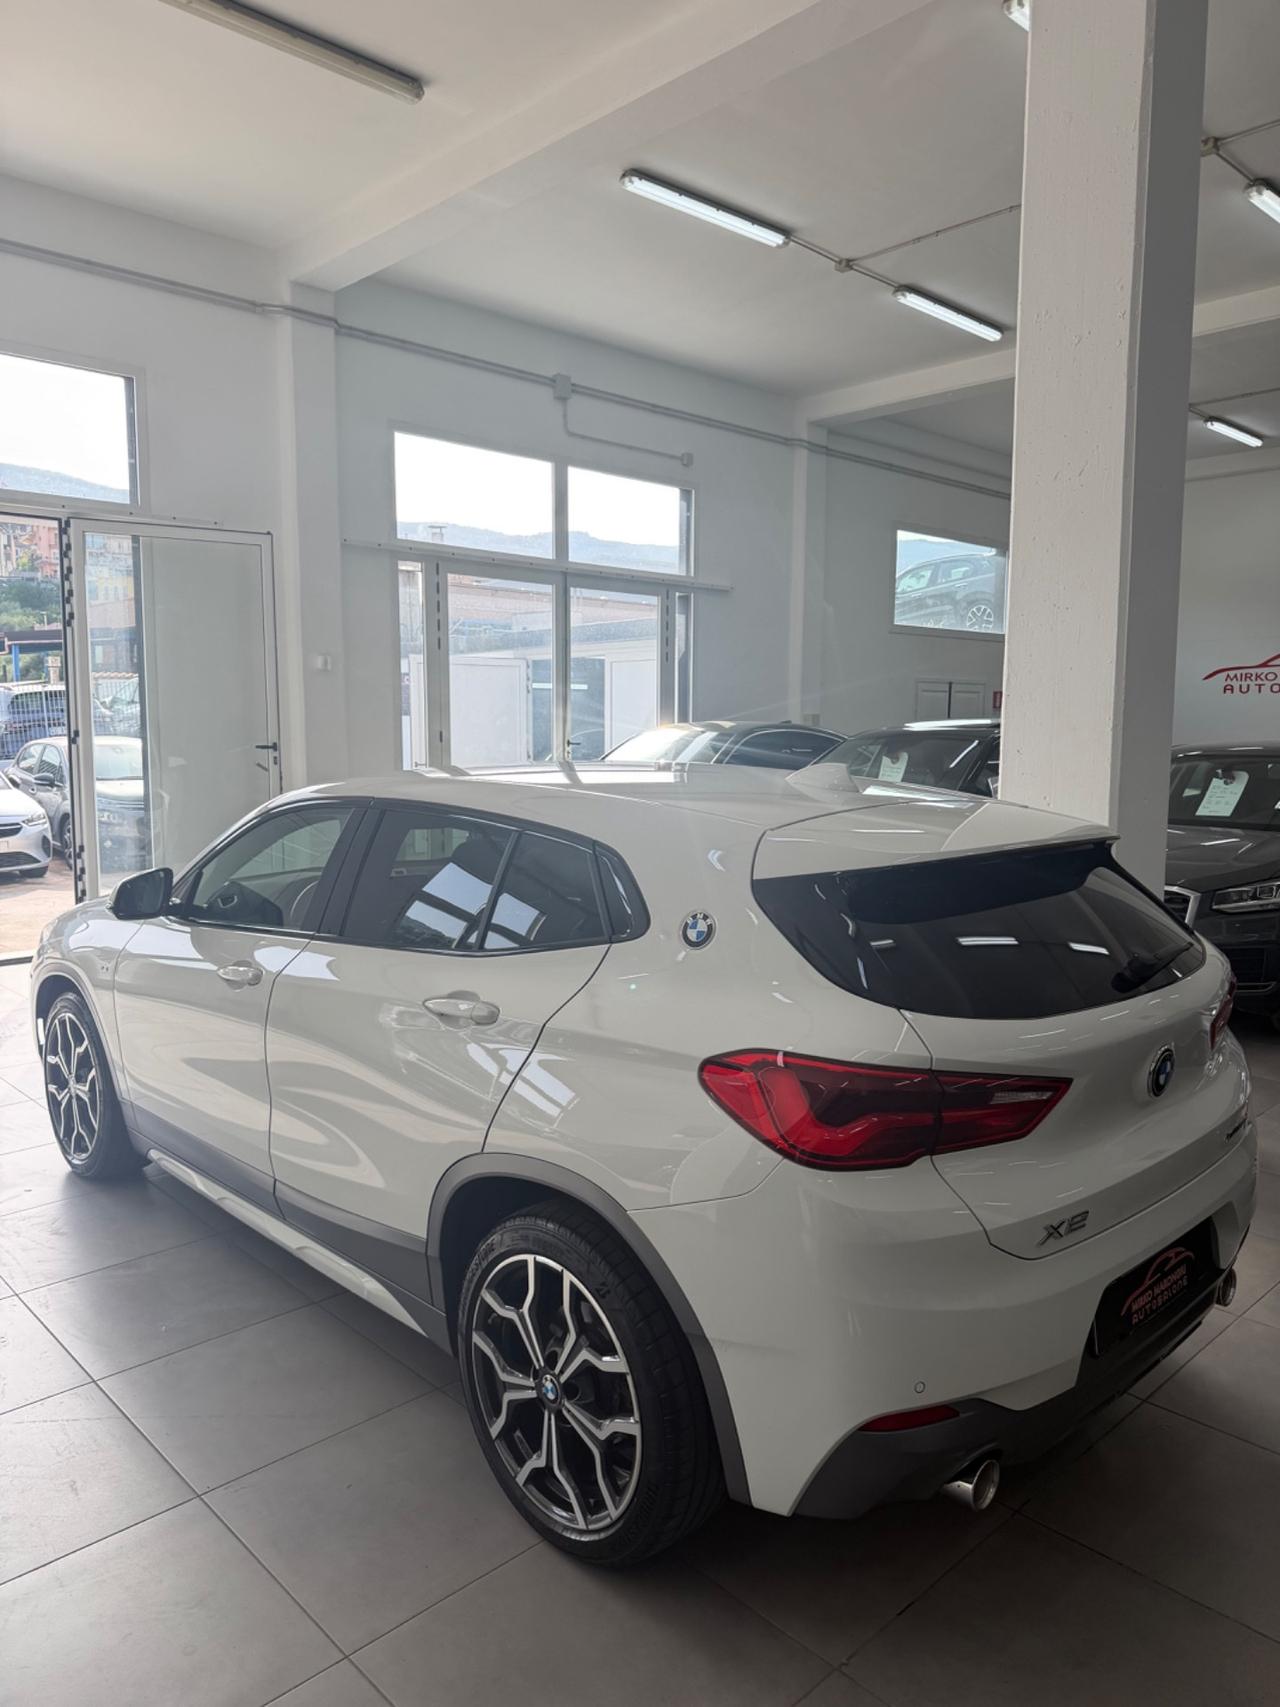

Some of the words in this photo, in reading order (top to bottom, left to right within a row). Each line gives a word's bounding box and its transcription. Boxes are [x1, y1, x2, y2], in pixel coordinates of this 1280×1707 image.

[1224, 672, 1278, 682] MIRKO
[1223, 683, 1280, 695] AUTO
[1036, 1210, 1089, 1247] X2
